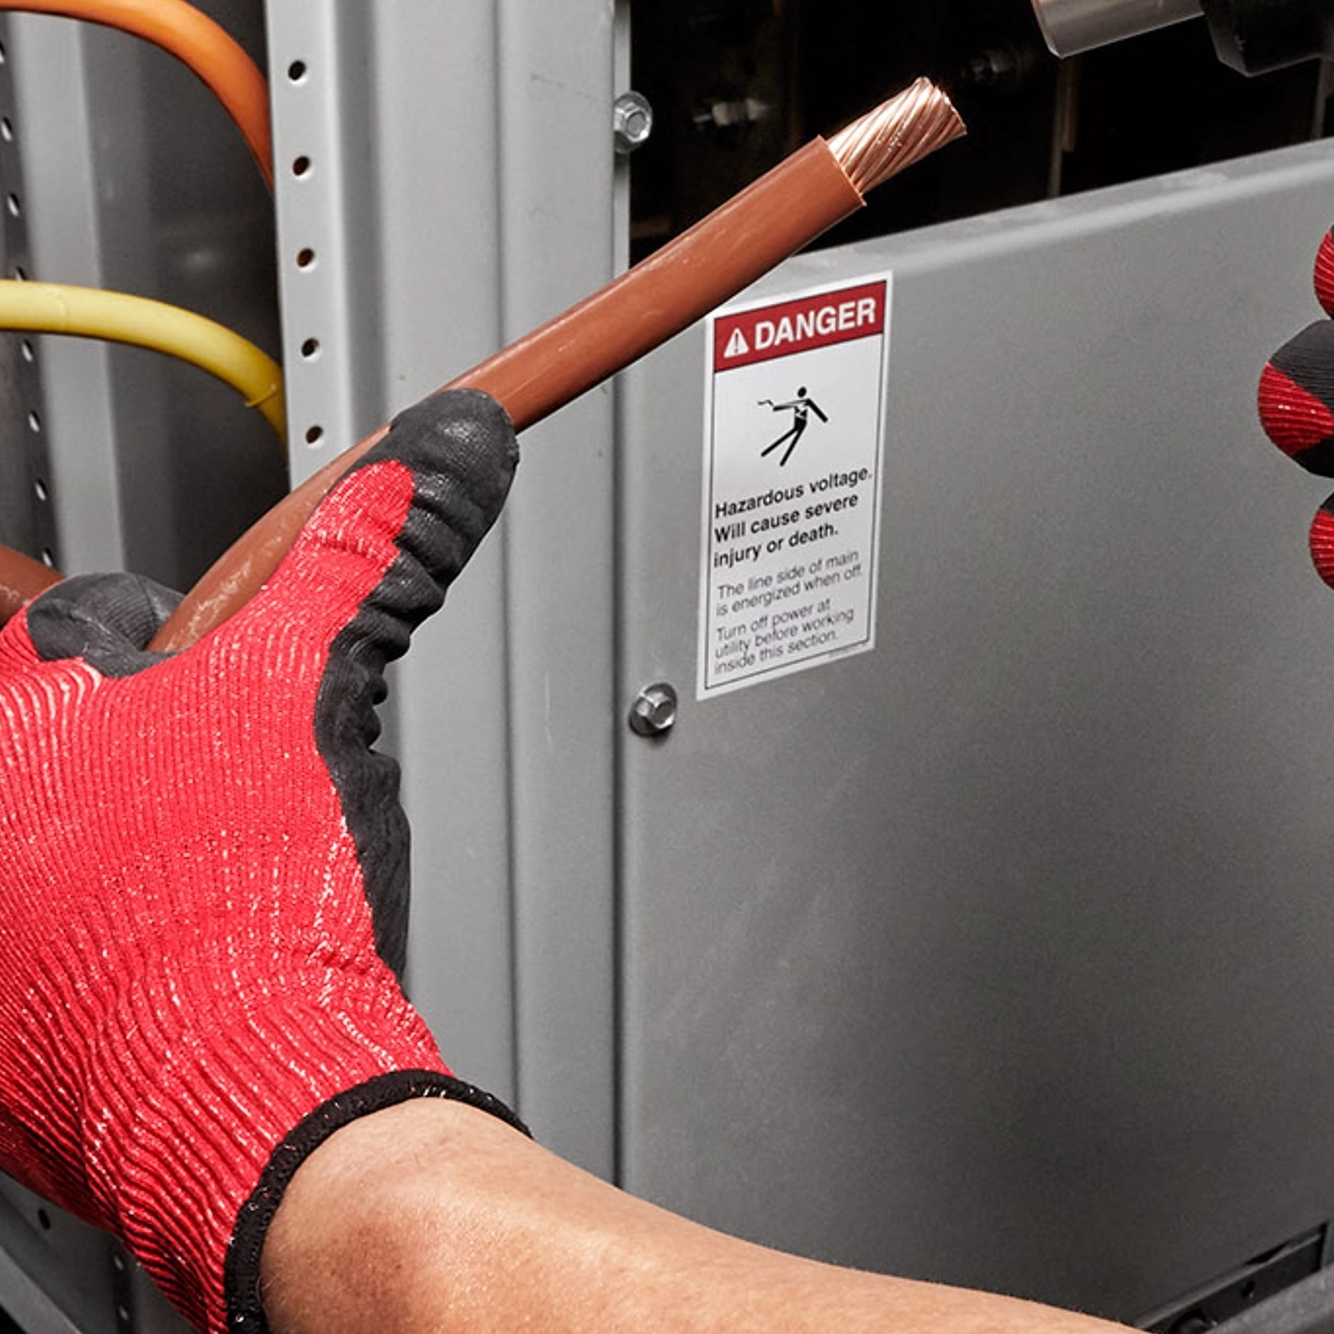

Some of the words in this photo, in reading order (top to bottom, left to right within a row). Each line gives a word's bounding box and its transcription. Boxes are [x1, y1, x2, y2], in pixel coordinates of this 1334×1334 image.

[754, 297, 877, 351] DANGER
[716, 484, 805, 519] Hazardous
[809, 467, 873, 494] voltage.
[714, 521, 747, 544] Will
[750, 509, 800, 534] cause
[805, 494, 859, 520] severe
[713, 544, 762, 569] injury
[767, 537, 784, 553] or
[788, 522, 839, 548] death.
[717, 603, 729, 616] is
[731, 582, 801, 613] energized
[804, 570, 841, 591] when
[718, 582, 745, 599] The
[748, 575, 774, 591] line
[777, 566, 806, 584] side
[809, 559, 823, 575] of
[825, 550, 860, 569] main
[715, 638, 751, 659] utility
[755, 626, 799, 648] before
[801, 608, 855, 634] working
[718, 623, 747, 642] Turn
[750, 615, 768, 632] off
[772, 604, 814, 629] power
[816, 598, 831, 613] at
[714, 651, 756, 675] inside
[759, 645, 784, 663] this
